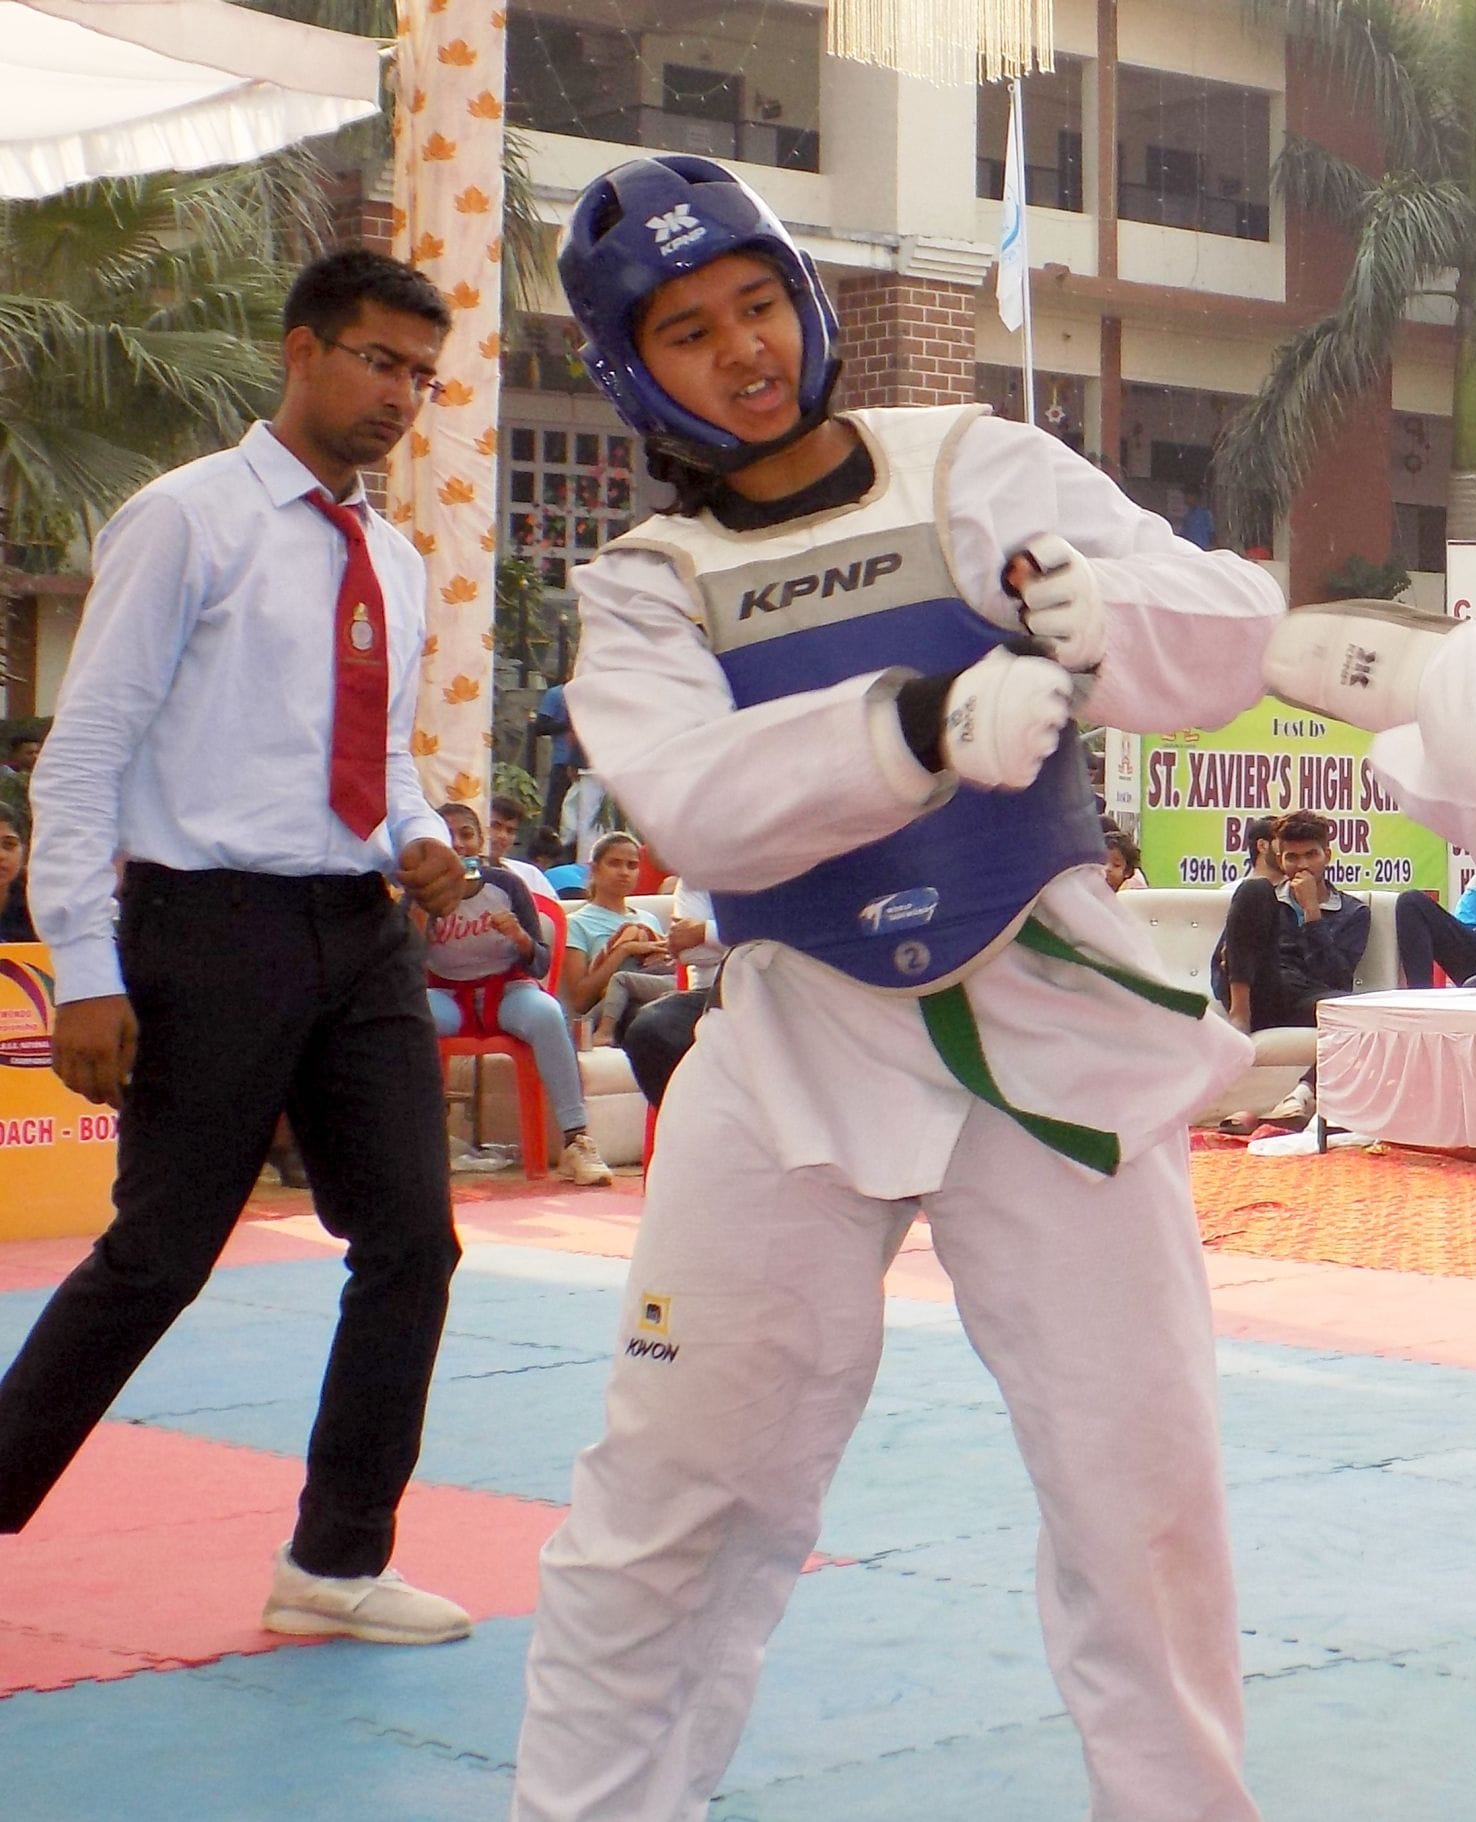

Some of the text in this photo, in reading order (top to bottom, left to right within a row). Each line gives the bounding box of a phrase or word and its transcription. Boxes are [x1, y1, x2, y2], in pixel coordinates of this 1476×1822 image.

[660, 227, 706, 256] KPNP
[739, 553, 902, 620] KPNP
[1273, 718, 1304, 737] Host
[1148, 750, 1180, 808] ST.
[1187, 752, 1291, 811] XAVIER'S
[1299, 756, 1353, 811] HIGH
[1180, 858, 1215, 882] 19th
[1221, 860, 1237, 882] to
[1374, 859, 1411, 883] 2019
[904, 947, 920, 970] 2
[625, 1337, 680, 1363] KWON
